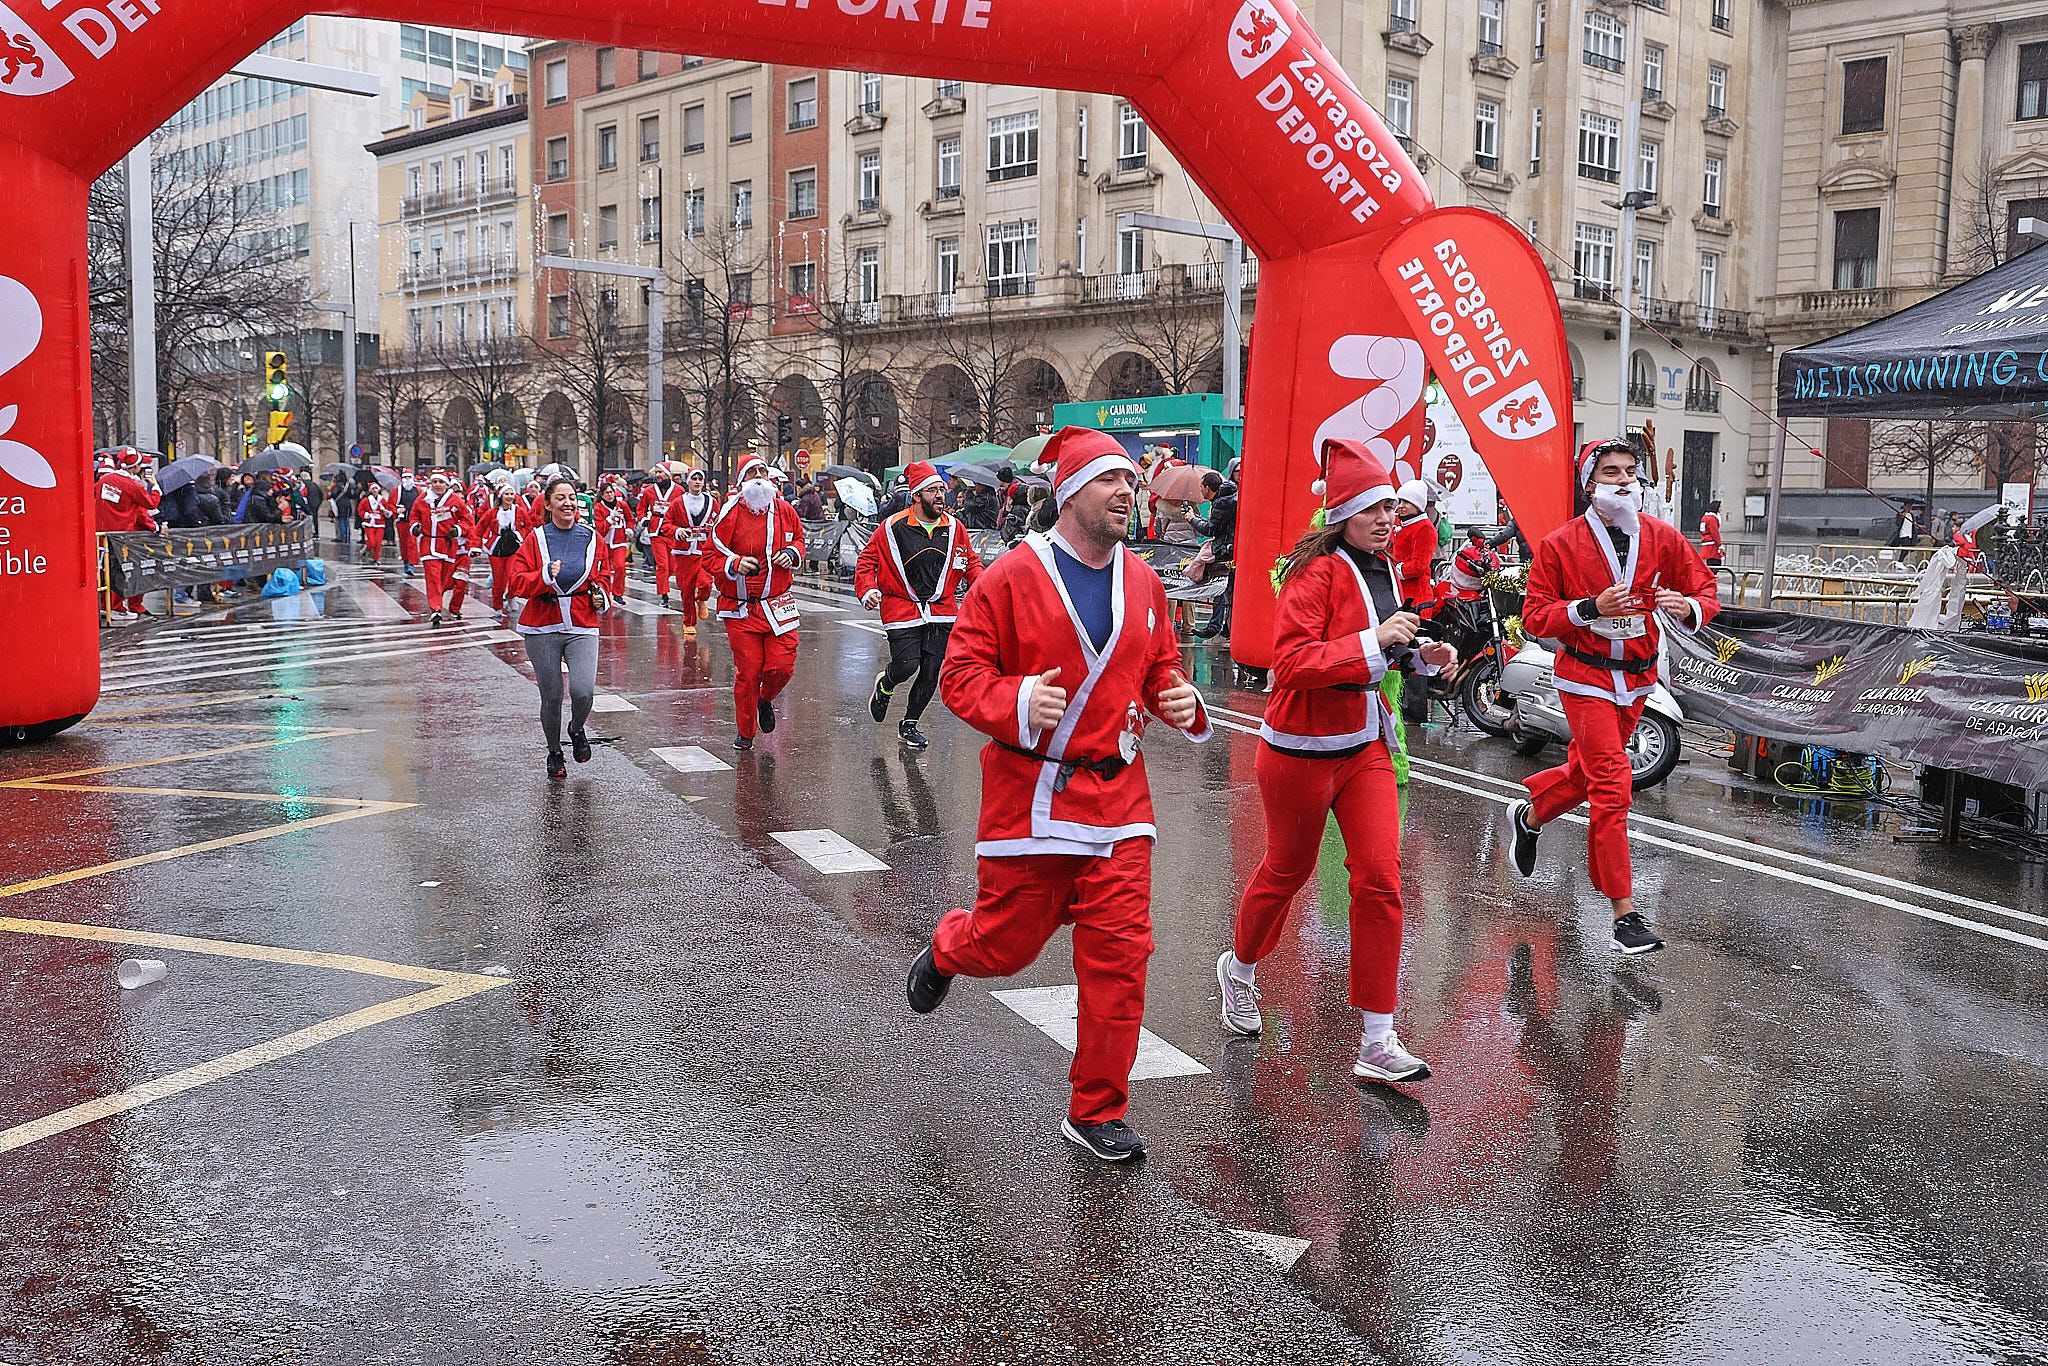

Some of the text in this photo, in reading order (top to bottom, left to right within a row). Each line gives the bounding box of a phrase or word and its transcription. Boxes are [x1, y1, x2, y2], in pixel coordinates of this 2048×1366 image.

[1288, 47, 1403, 194] Zaragoza
[1255, 73, 1381, 224] DEPORTE
[1110, 403, 1147, 416] CAJA RURAL
[1113, 416, 1143, 426] DE ARAGÓN
[1612, 618, 1632, 630] 504
[1673, 673, 1685, 683] DE
[1678, 656, 1743, 686] CAJA RURAL
[1771, 684, 1836, 703] CAJA RURAL
[1858, 687, 1929, 703] CAJA RURAL
[1764, 699, 1778, 709] DE
[1851, 702, 1909, 717] DE ARAGÓN
[1967, 699, 2048, 725] CAJA RUR
[1965, 716, 1985, 731] DE
